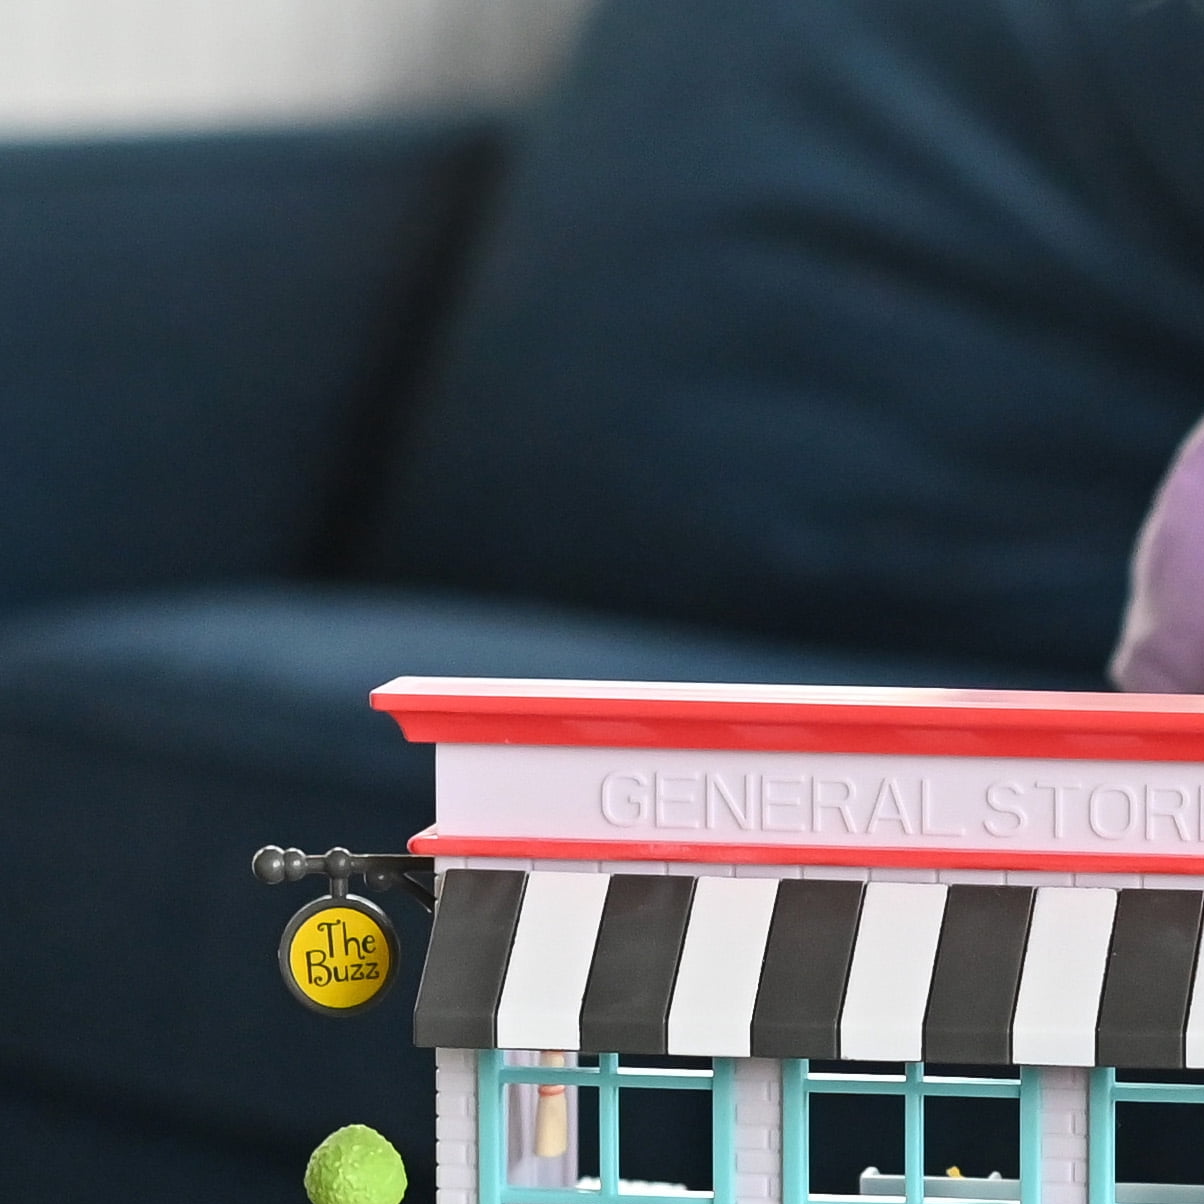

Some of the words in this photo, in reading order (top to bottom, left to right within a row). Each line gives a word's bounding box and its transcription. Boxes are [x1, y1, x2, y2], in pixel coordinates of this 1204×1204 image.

[599, 769, 966, 837] GENERAL
[317, 919, 376, 960] The
[305, 949, 380, 987] Buzz
